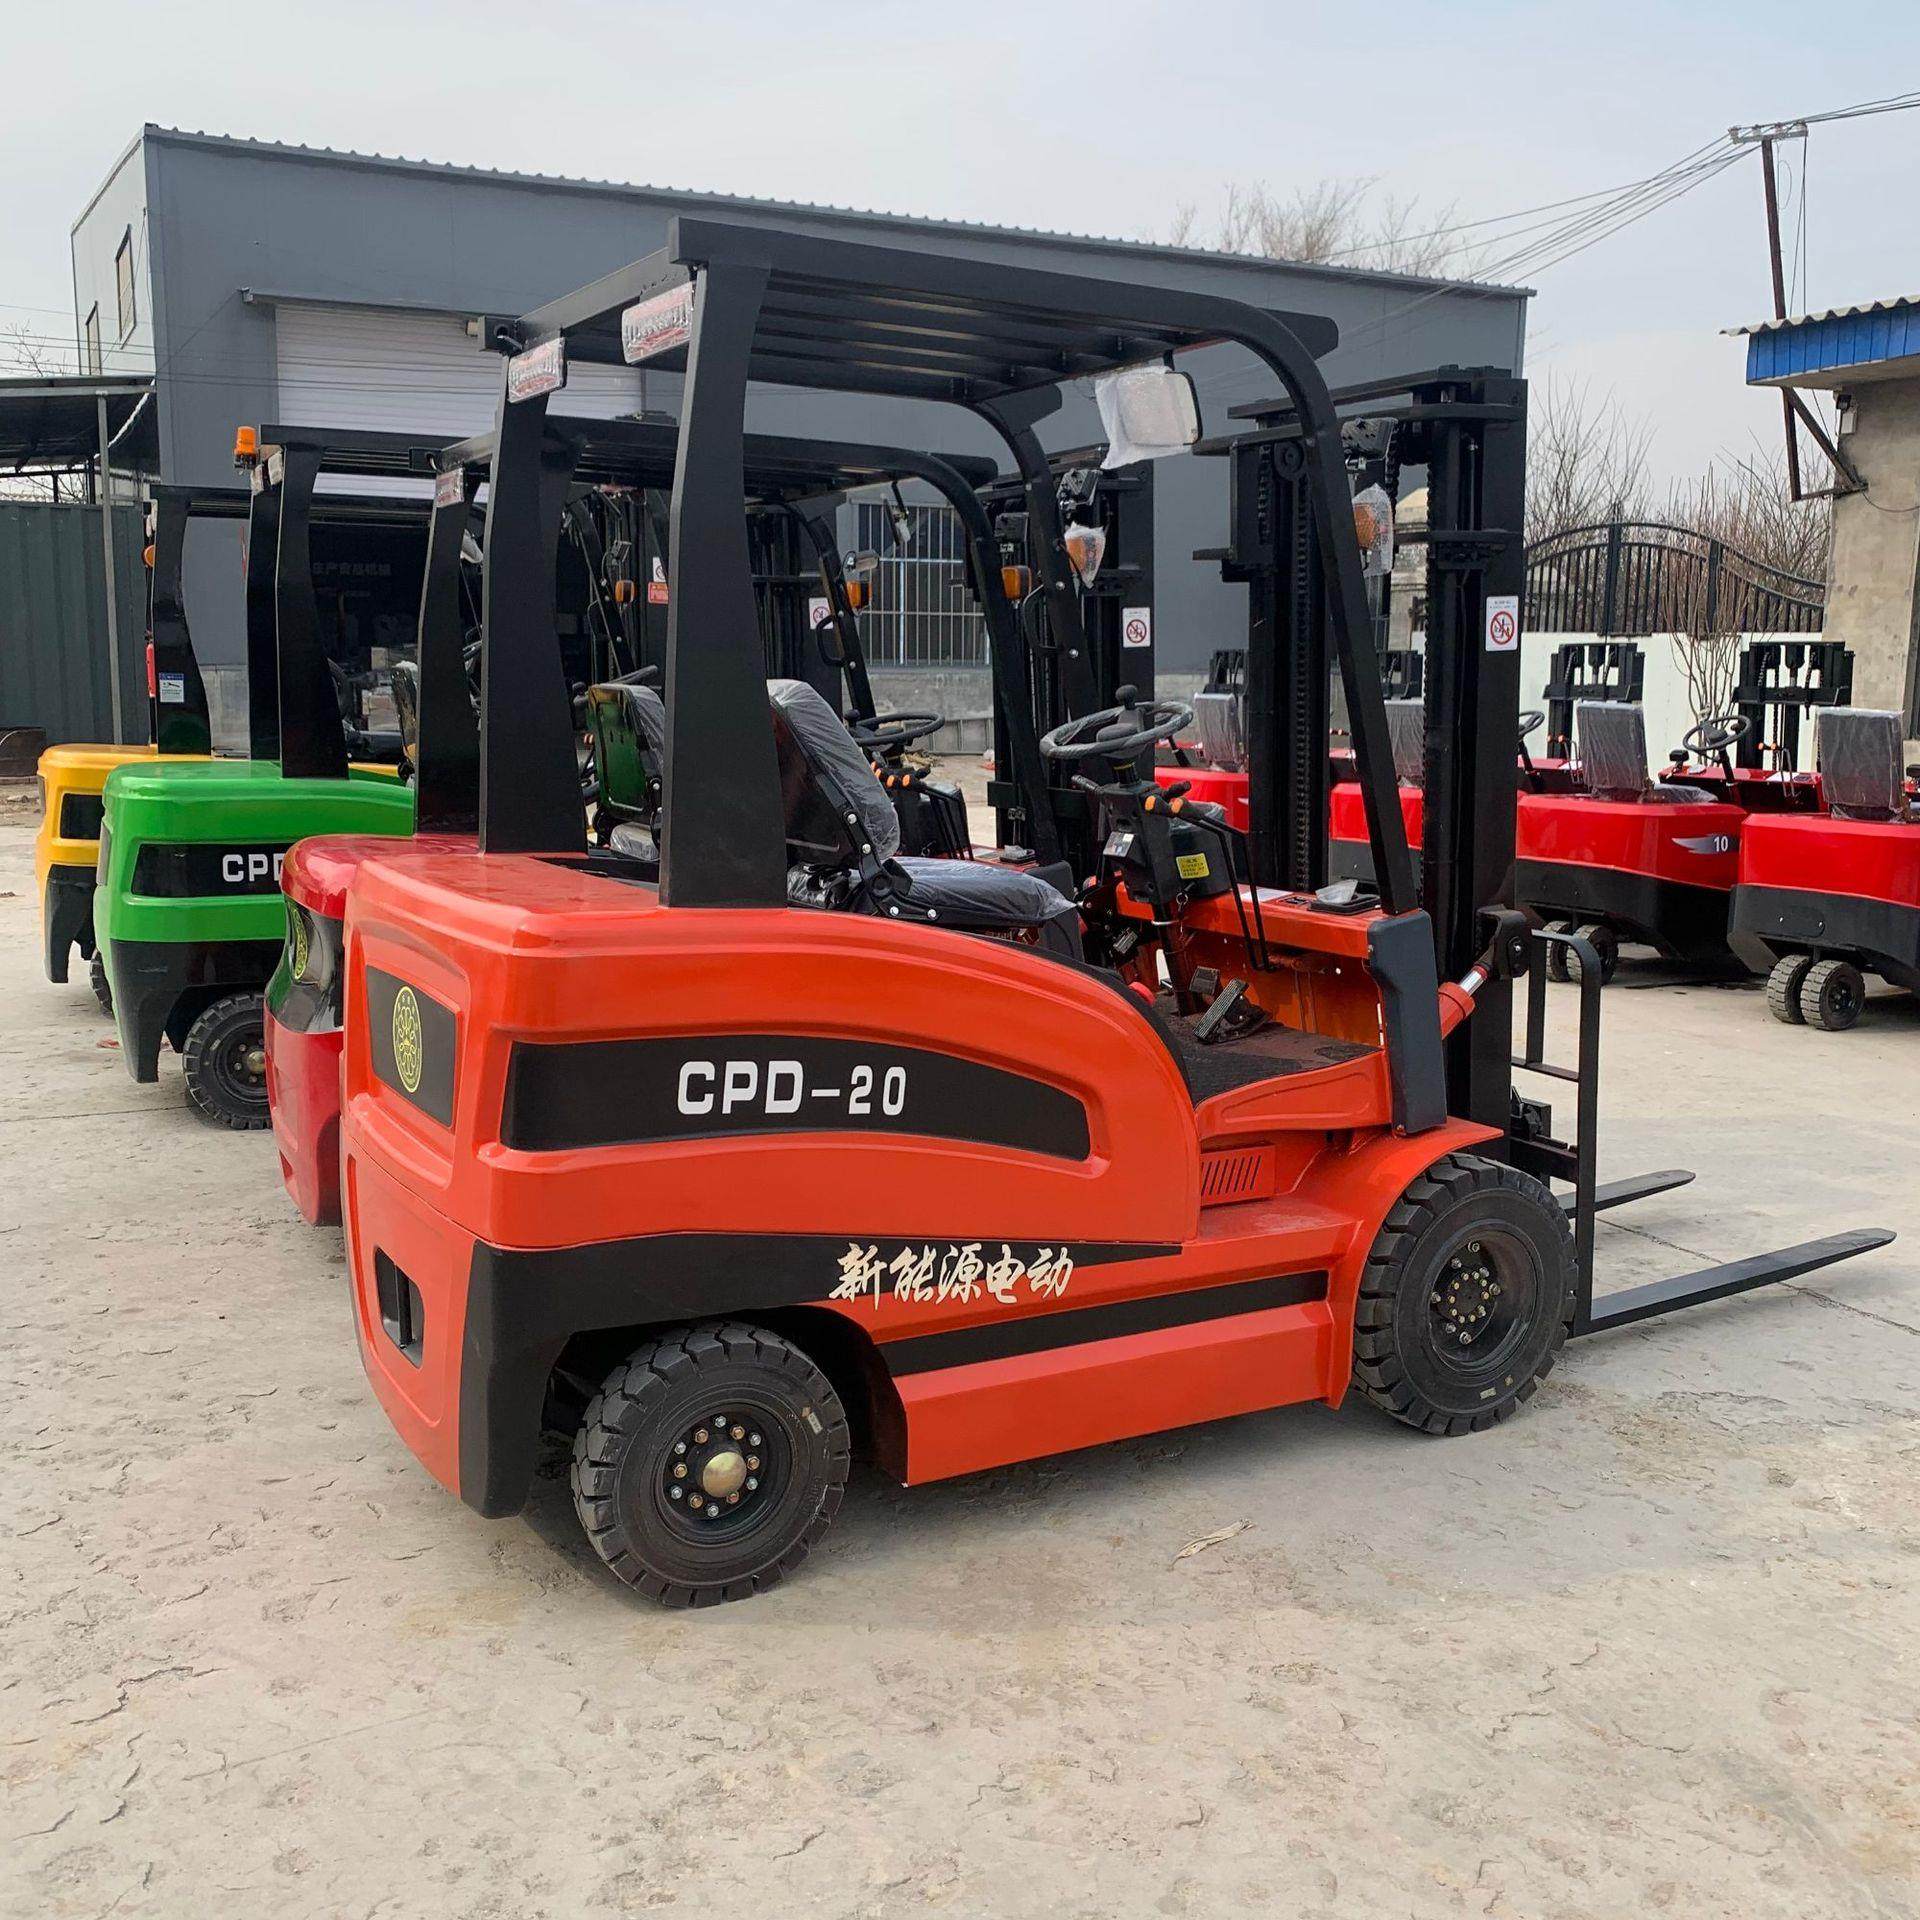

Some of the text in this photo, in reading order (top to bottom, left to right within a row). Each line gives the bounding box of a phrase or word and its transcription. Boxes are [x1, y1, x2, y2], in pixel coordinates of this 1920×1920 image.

[1713, 835, 1729, 852] 10
[677, 1061, 907, 1116] CPD-20
[828, 1242, 1074, 1310] 新能源电动
